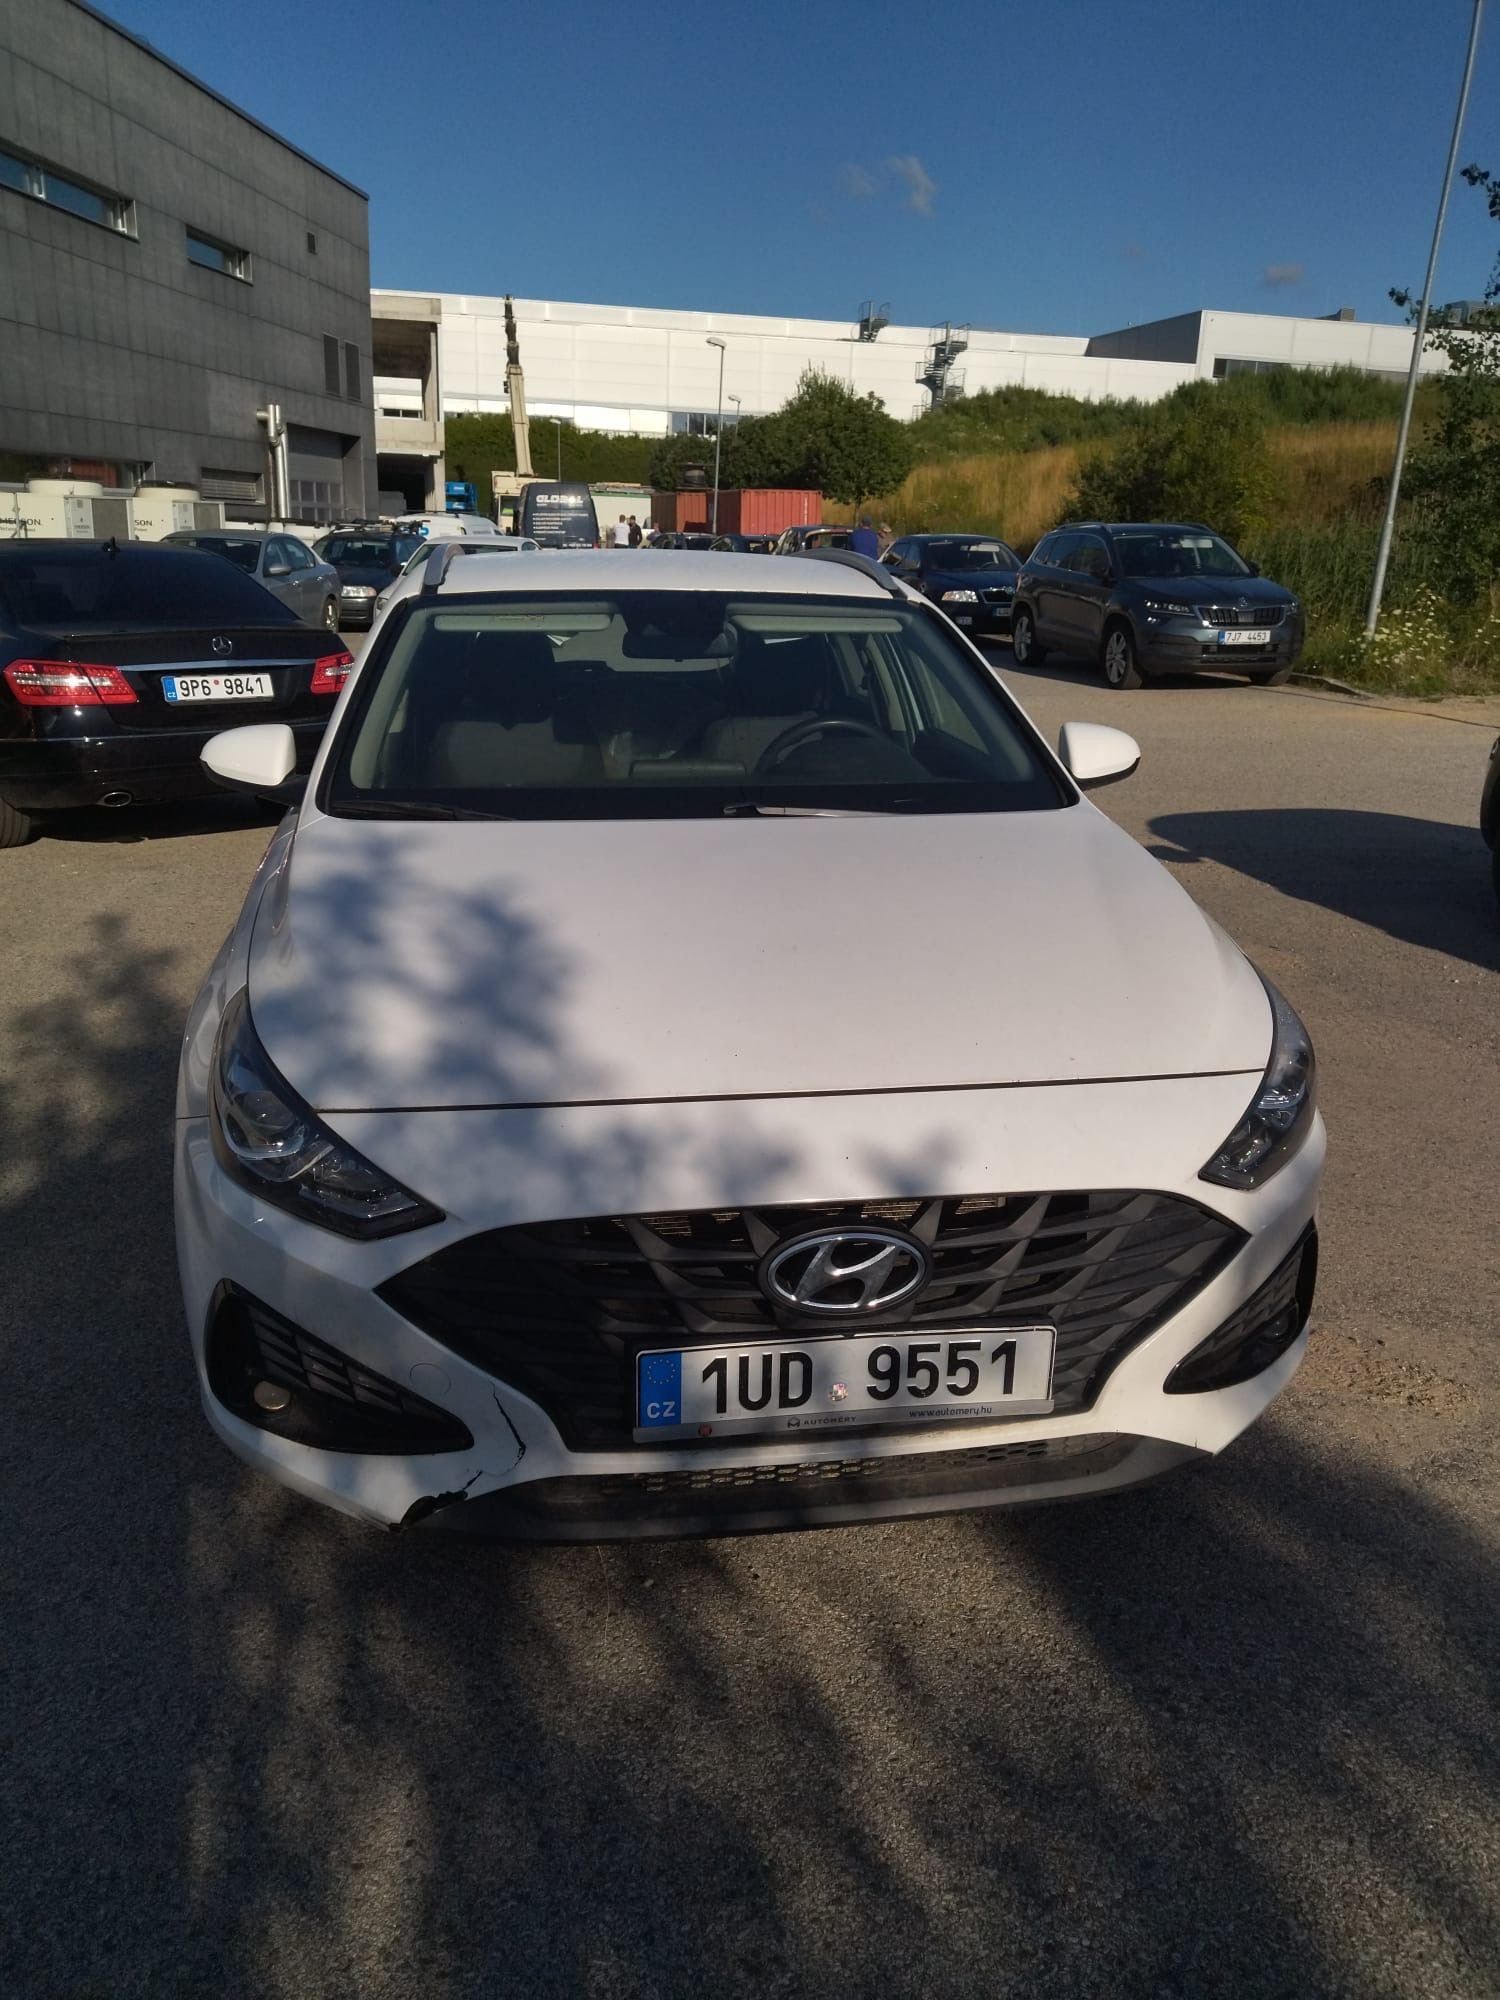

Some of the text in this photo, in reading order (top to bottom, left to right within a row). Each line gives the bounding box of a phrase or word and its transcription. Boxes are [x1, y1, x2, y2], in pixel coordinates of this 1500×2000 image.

[535, 494, 584, 504] GLOBL
[180, 679, 211, 697] 9P6
[223, 677, 264, 696] 9841
[646, 1339, 1017, 1419] CZ 1UD 9551
